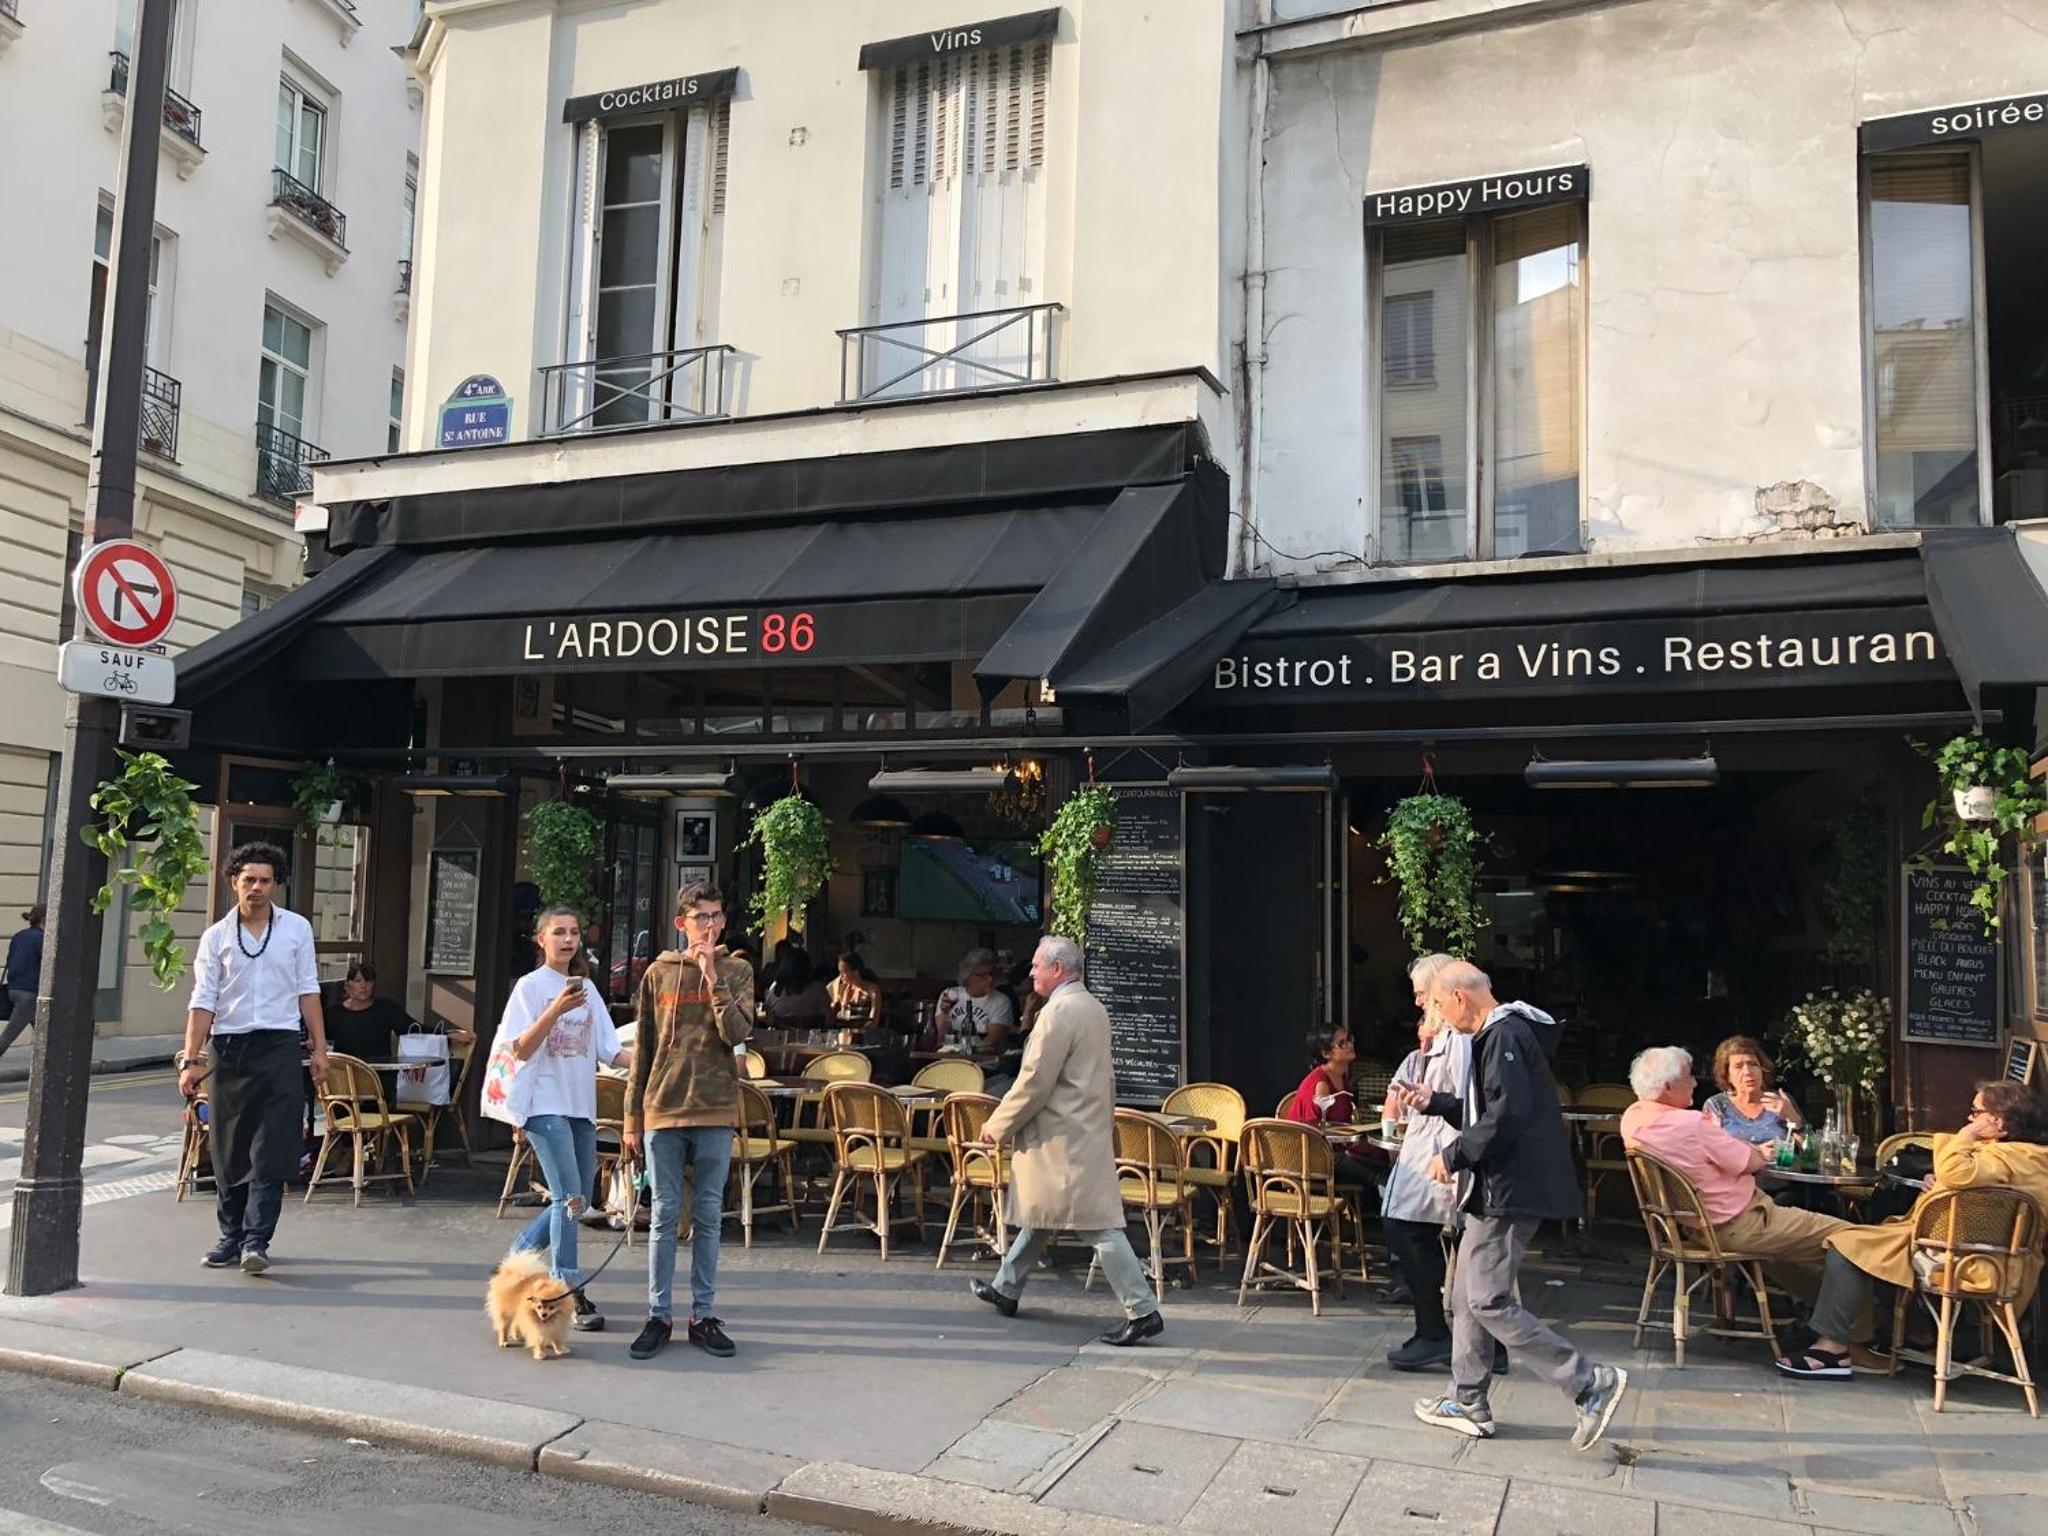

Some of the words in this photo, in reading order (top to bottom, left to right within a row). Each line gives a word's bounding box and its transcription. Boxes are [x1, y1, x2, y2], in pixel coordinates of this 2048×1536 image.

[930, 29, 982, 53] Vins
[600, 78, 698, 111] Cocktails
[1931, 101, 2048, 135] soirée
[1376, 187, 1473, 217] Happy
[1482, 172, 1574, 202] Hours
[464, 411, 487, 424] RUE
[455, 425, 504, 441] ANTOINE
[523, 614, 749, 660] L'ARDOISE
[761, 611, 816, 654] 86
[100, 650, 145, 669] SAUF
[1214, 653, 1352, 689] Bistrot
[1391, 649, 1464, 683] Bar
[1477, 651, 1501, 680] a
[1516, 641, 1621, 679] Vins
[1664, 629, 1938, 673] Restauran
[1912, 876, 1940, 889] VINS
[1926, 890, 1970, 901] COCKTAI
[1915, 901, 1950, 916] HAPPY
[1913, 968, 1944, 981] MENU
[1928, 996, 1973, 1009] GLACES
